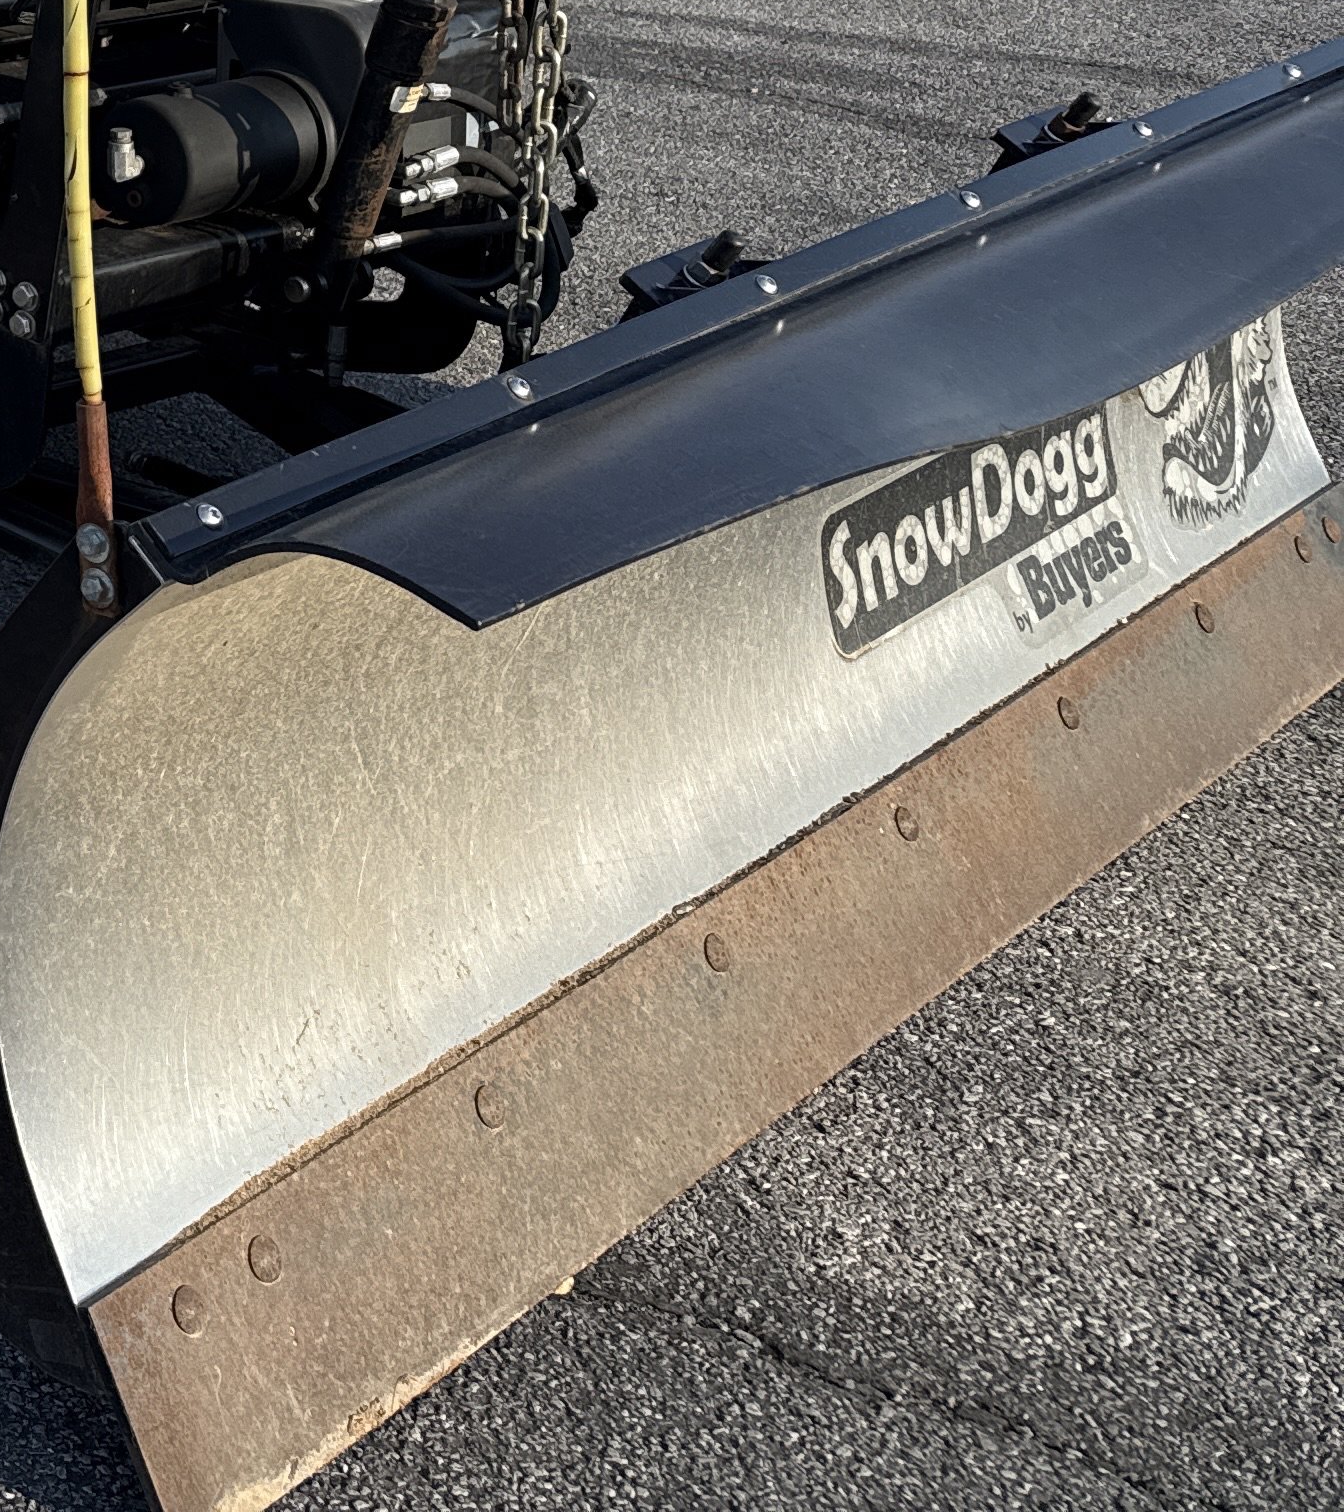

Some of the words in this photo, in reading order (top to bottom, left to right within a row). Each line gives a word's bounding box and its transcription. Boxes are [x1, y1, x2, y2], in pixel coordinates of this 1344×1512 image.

[829, 413, 1108, 629] SnowDogg
[1017, 520, 1132, 621] Buyers
[1013, 610, 1033, 634] by
